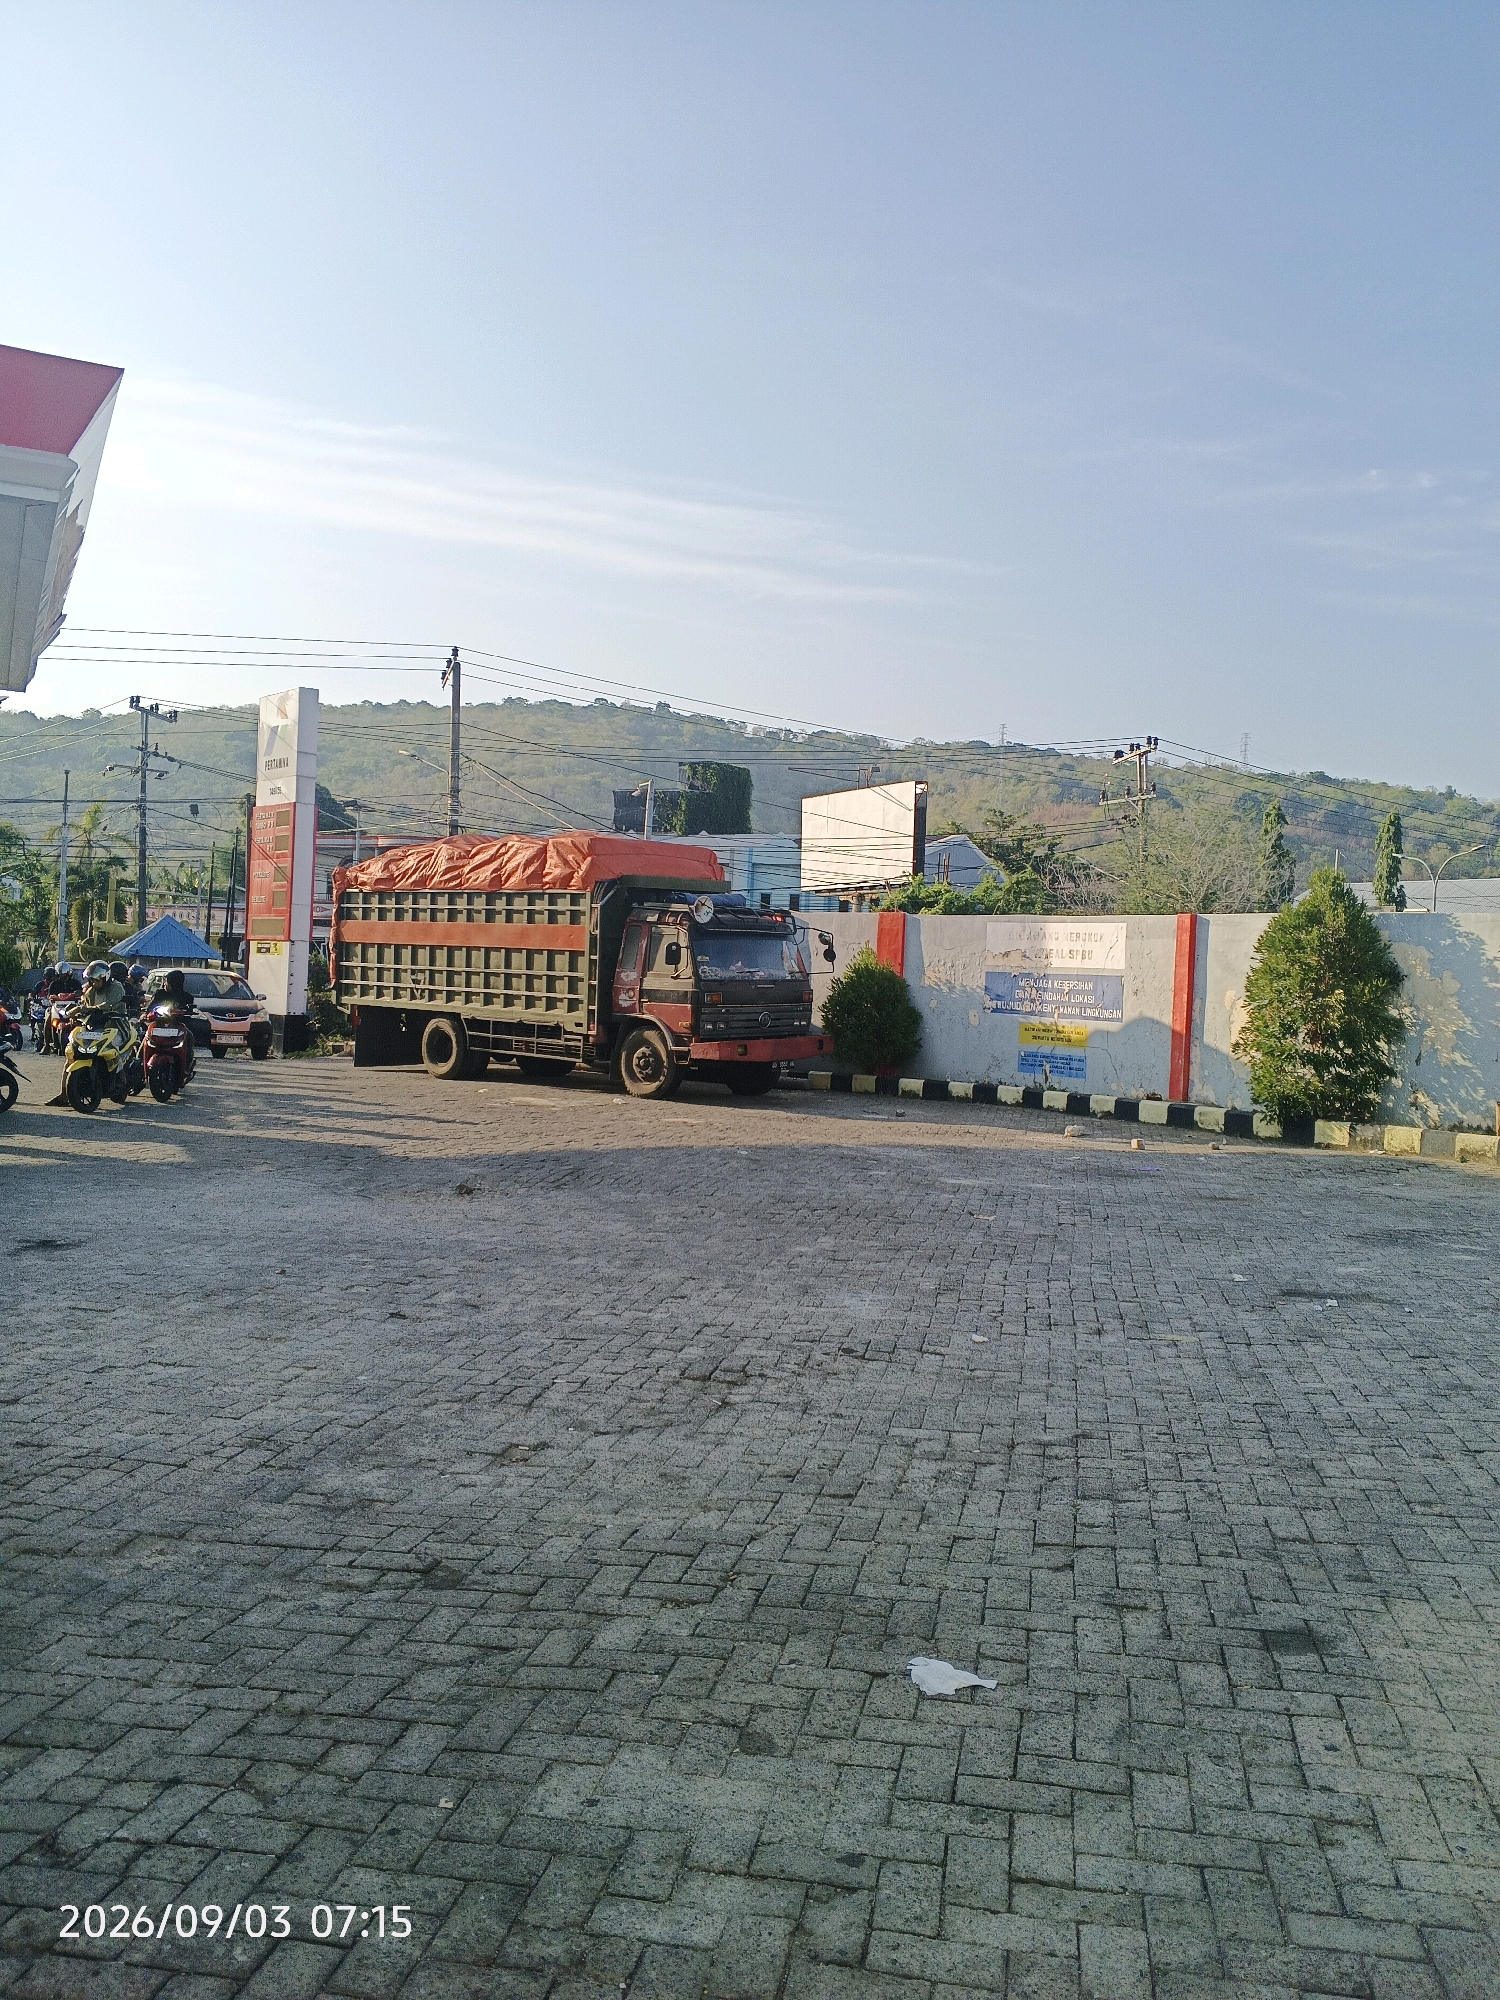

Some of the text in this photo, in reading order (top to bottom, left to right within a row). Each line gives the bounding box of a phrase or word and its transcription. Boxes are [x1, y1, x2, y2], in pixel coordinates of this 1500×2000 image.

[1068, 949, 1093, 961] SPBU
[1018, 977, 1094, 991] MENJAGA KEBERSIHAN
[1070, 994, 1095, 1004] LOKASI
[1081, 1008, 1122, 1019] LINGKUNGAN
